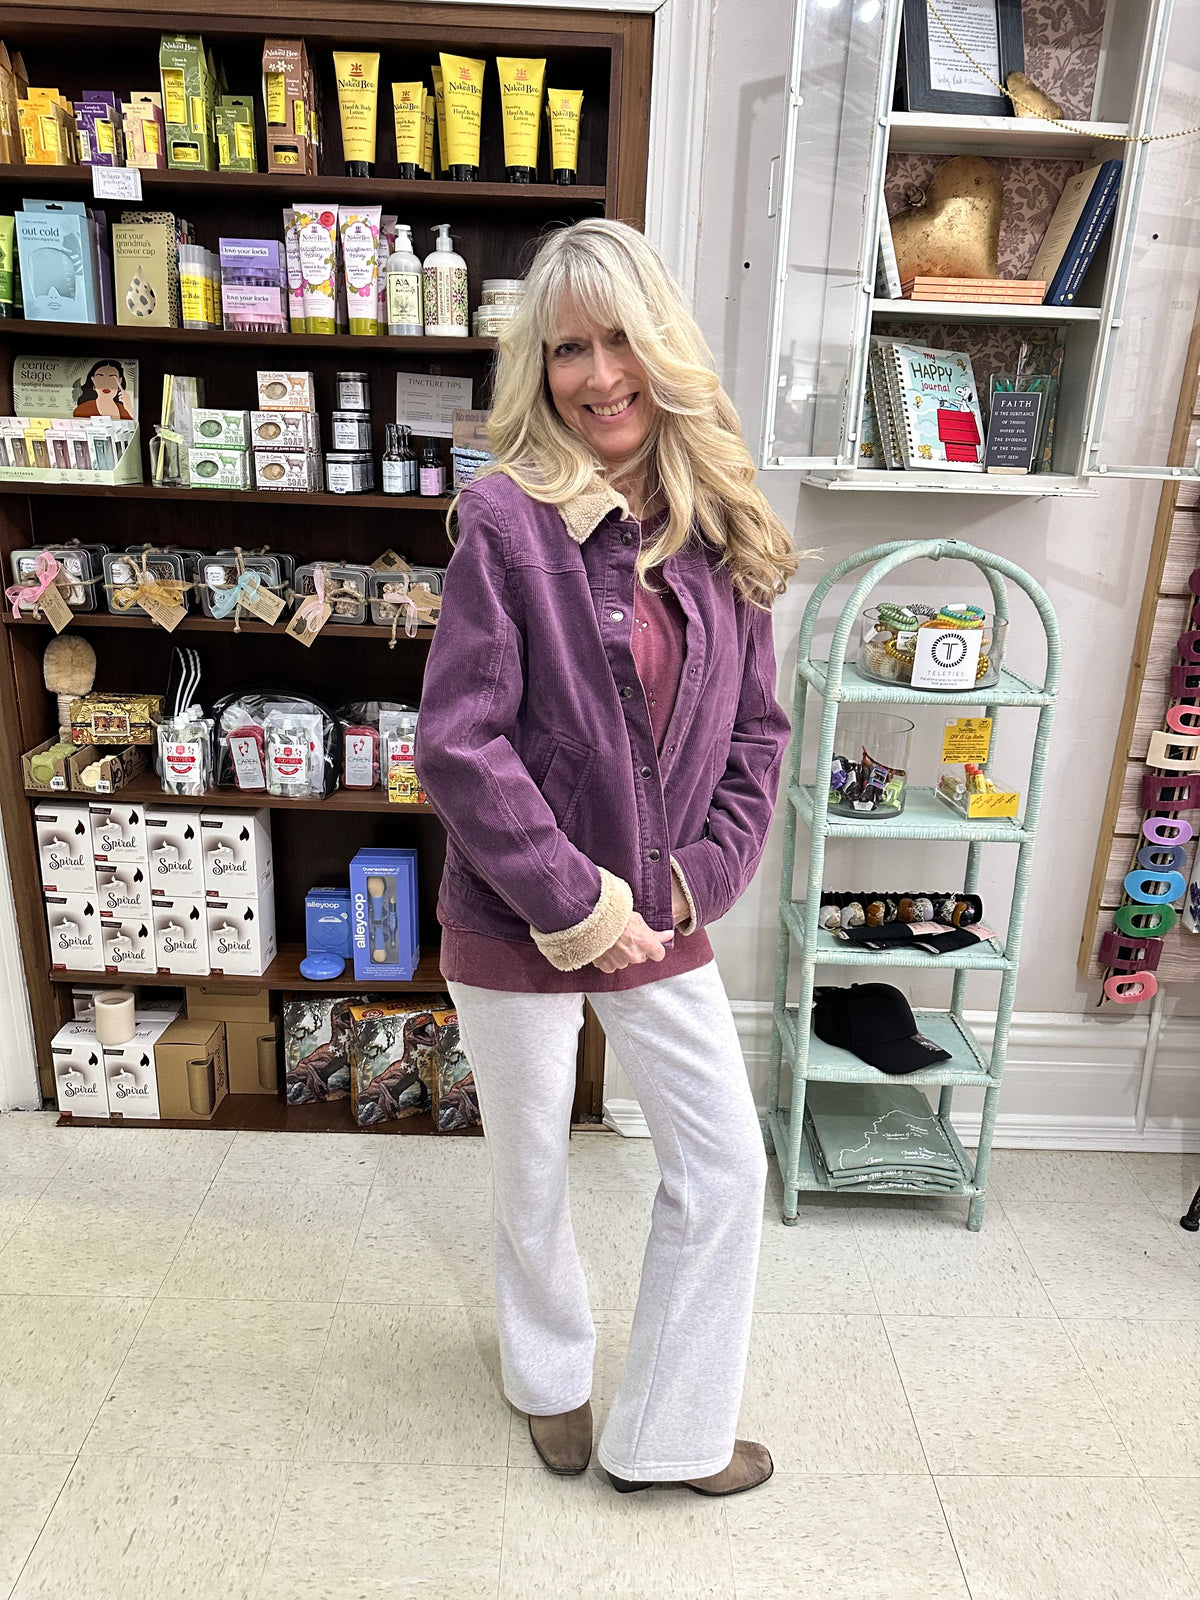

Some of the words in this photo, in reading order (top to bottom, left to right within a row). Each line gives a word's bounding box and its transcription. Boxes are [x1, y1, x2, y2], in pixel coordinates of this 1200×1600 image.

[162, 42, 184, 50] Naked
[265, 49, 285, 57] Naked
[338, 80, 360, 88] Naked
[361, 80, 374, 88] Bee
[449, 82, 470, 91] Naked
[471, 84, 482, 94] Bee
[503, 84, 526, 93] Naked
[526, 85, 538, 93] Bee
[22, 228, 37, 236] out
[39, 227, 59, 237] cold
[126, 233, 144, 241] your
[116, 240, 151, 248] grandma's
[117, 247, 141, 255] shower
[143, 249, 156, 257] cap
[923, 352, 936, 364] my
[22, 361, 58, 371] center
[21, 370, 52, 382] stage
[911, 362, 953, 383] HAPPY
[409, 379, 443, 388] TINCTURE
[920, 380, 950, 392] journal
[289, 397, 308, 405] SOAP
[456, 413, 465, 421] No
[465, 414, 479, 422] more
[224, 436, 243, 444] SOAP
[102, 835, 137, 851] Spiral
[49, 853, 84, 870] Spiral
[158, 858, 193, 874] Spiral
[212, 859, 248, 875] Spiral
[107, 892, 141, 908] Spiral
[307, 901, 339, 909] alleyoop
[355, 893, 367, 948] alleyoop
[59, 933, 93, 949] Spiral
[164, 937, 198, 953] Spiral
[217, 938, 251, 954] Spiral
[112, 947, 146, 963] Spiral
[385, 998, 436, 1010] RAPTOR
[70, 1026, 96, 1035] Spira
[135, 1029, 152, 1037] iral
[64, 1082, 98, 1098] Spiral
[116, 1083, 149, 1099] Spiral
